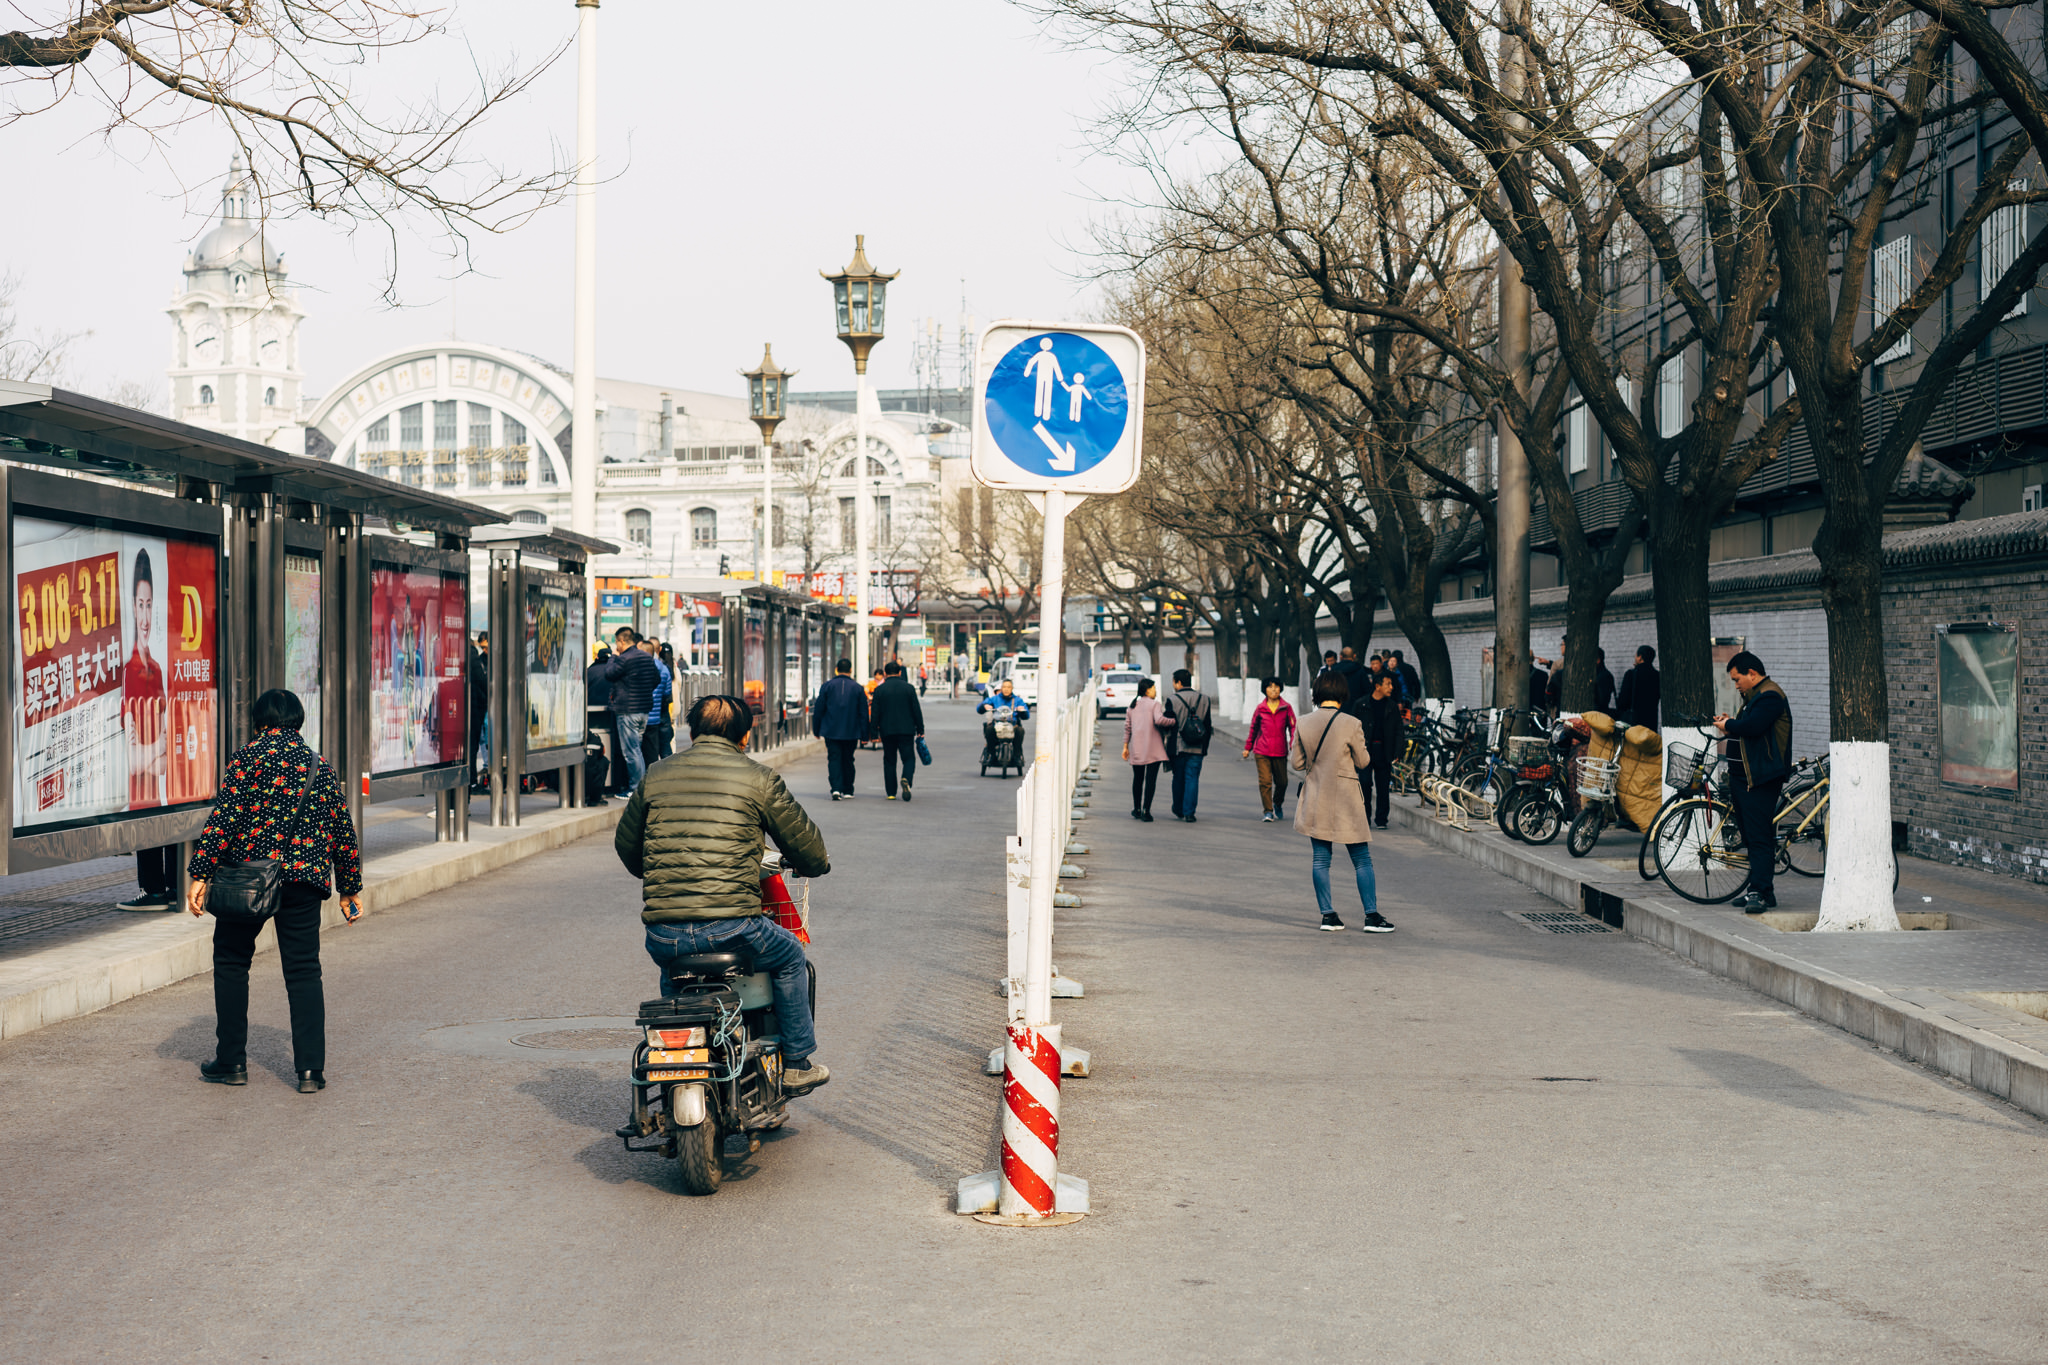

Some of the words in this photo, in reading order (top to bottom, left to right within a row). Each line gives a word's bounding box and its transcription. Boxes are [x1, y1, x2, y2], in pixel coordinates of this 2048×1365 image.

[359, 443, 532, 468] 中国铁道博物馆
[411, 471, 466, 485] RAILWAY
[476, 469, 529, 482] MUSEUM
[20, 558, 116, 658] 3.08-3.17
[26, 654, 74, 717] 买空调
[76, 635, 121, 695] 去大中
[173, 658, 211, 683] 大中电器
